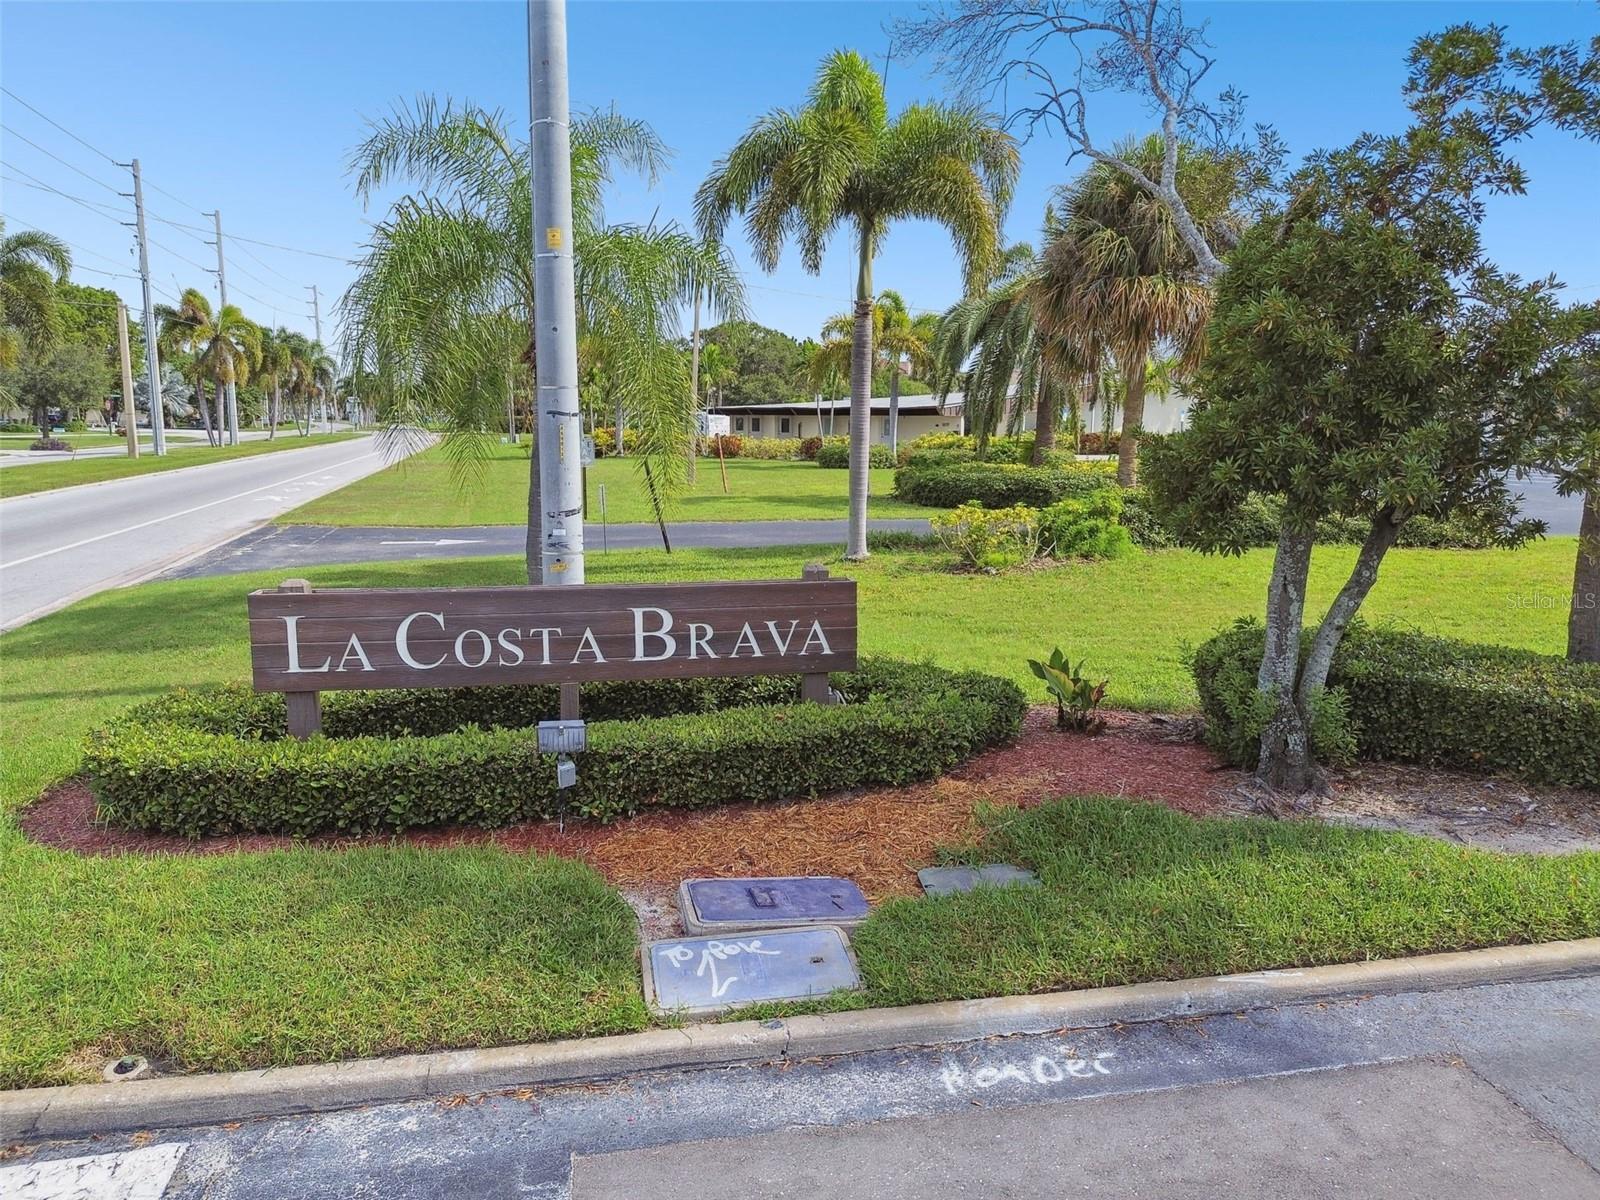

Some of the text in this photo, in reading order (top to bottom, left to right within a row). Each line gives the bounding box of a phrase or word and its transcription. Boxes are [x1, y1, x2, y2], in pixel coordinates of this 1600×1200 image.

[278, 608, 834, 673] LA COSTA BRAVA
